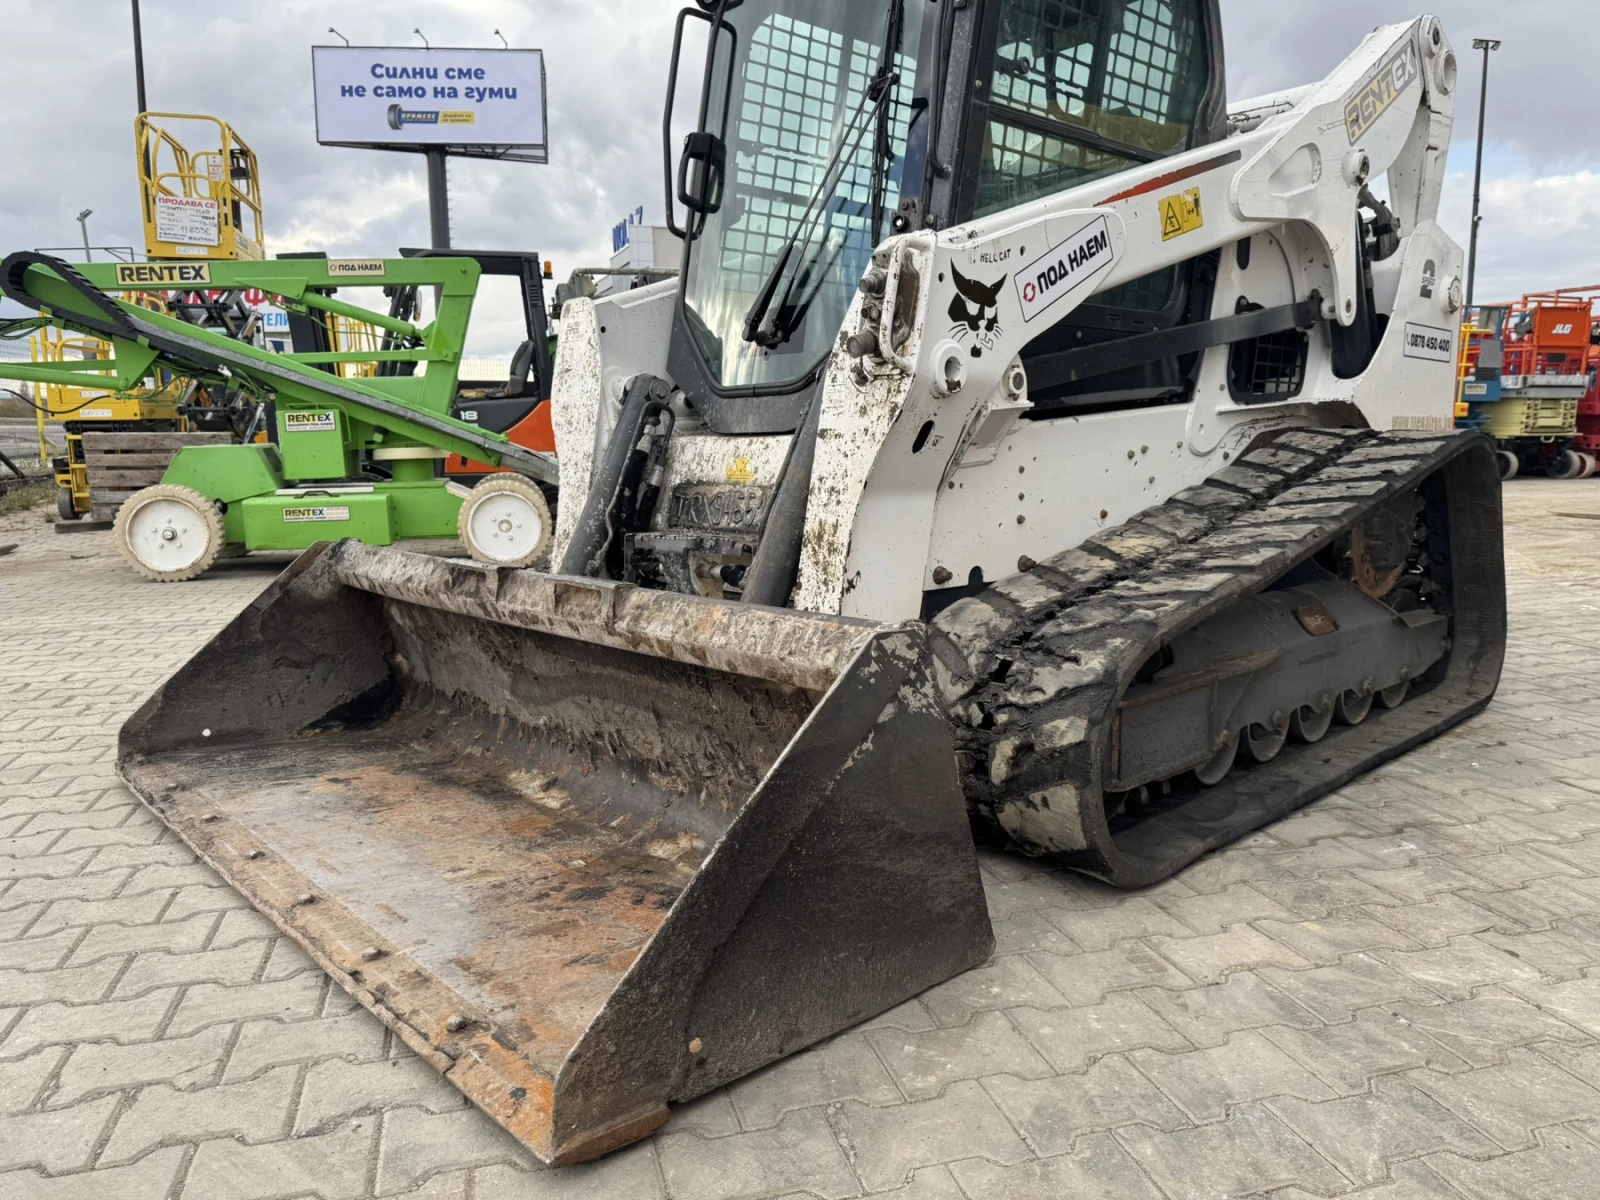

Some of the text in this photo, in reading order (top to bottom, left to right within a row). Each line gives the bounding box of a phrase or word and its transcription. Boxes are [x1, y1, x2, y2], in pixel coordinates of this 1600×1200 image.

[370, 63, 485, 80] Силни сме
[340, 84, 517, 102] не само на гуми
[1347, 46, 1415, 140] RENTEX
[158, 197, 203, 208] ПРОДАВА
[1037, 230, 1107, 294] ПОД НАЕМ
[120, 265, 206, 282] RENTEX
[1551, 323, 1573, 334] JLG
[1410, 333, 1450, 352] 0878 450 400
[287, 413, 331, 423] RENTEX
[460, 411, 478, 420] 18
[284, 508, 324, 517] RENTEX
